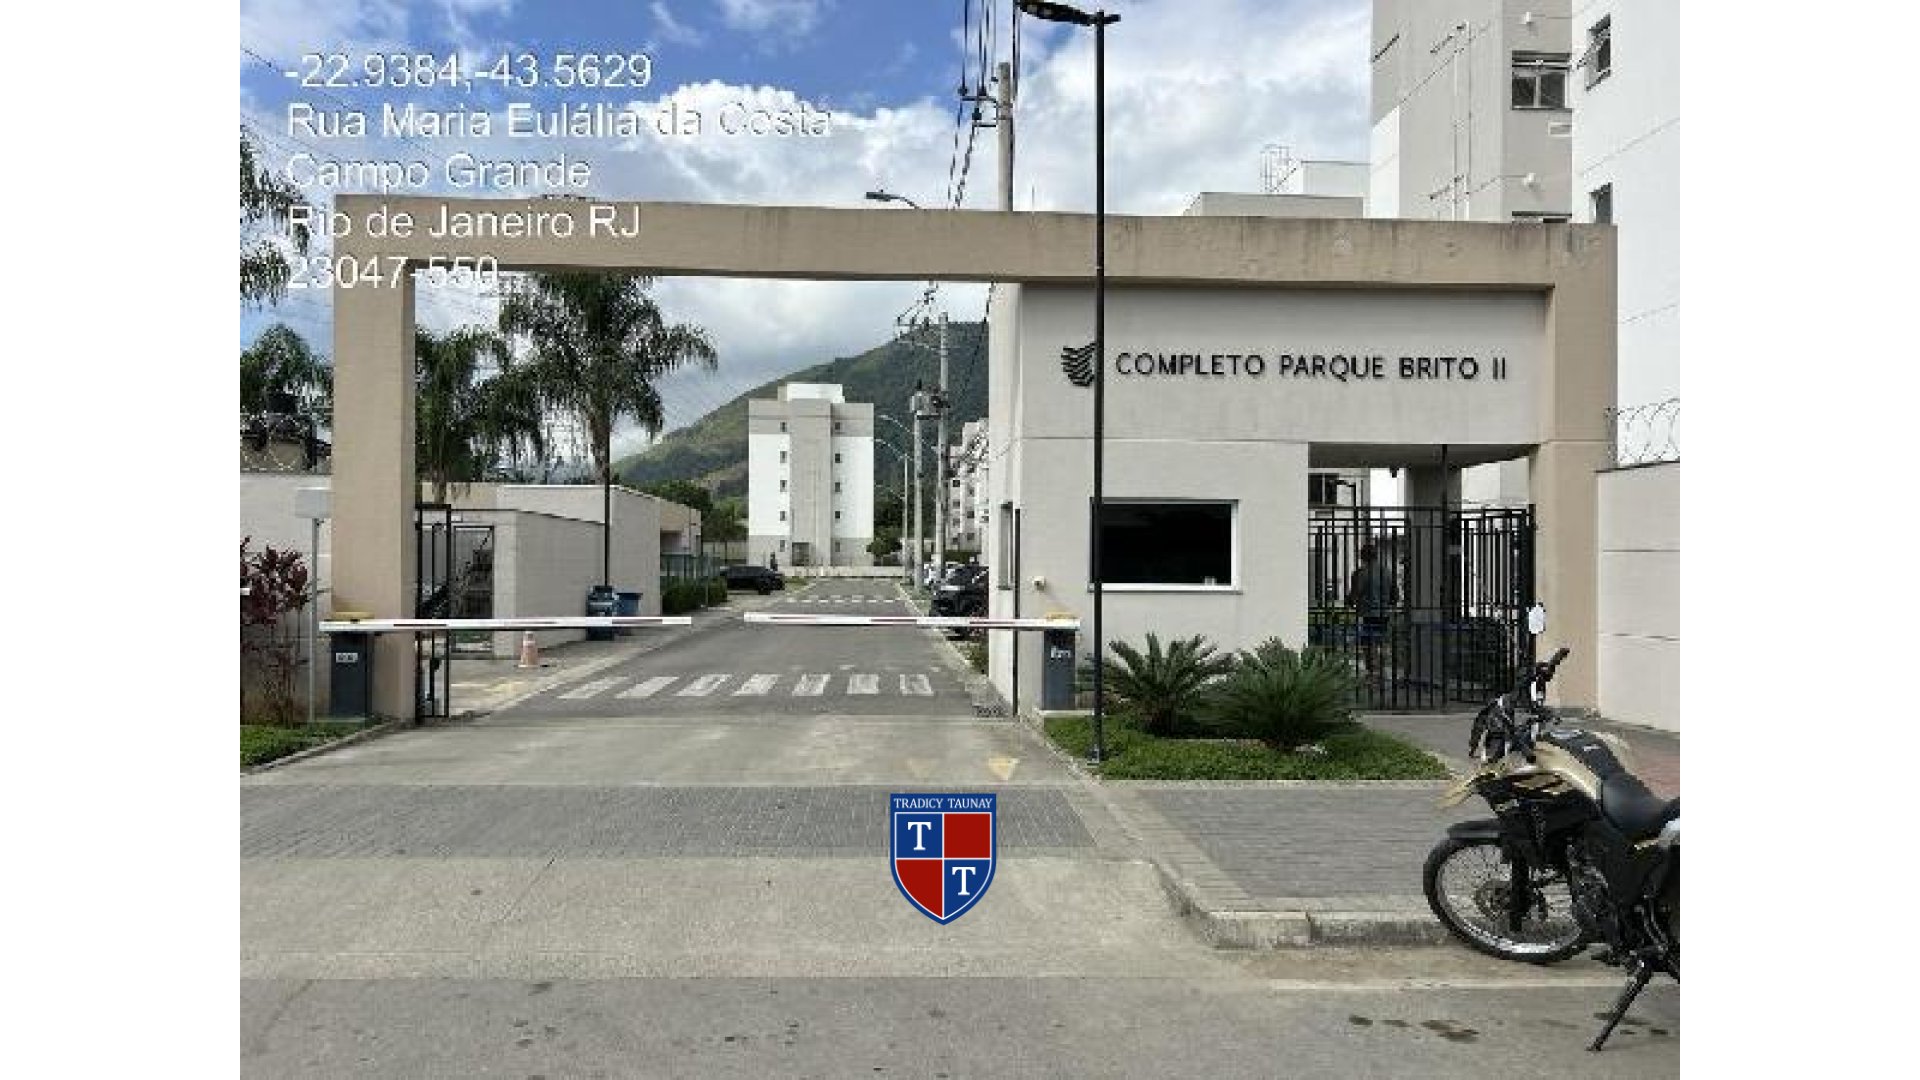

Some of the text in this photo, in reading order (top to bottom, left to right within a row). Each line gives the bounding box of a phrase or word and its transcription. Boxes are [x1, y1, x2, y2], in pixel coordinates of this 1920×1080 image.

[1115, 352, 1507, 382] COMPLETO PARQUE BRITO II
